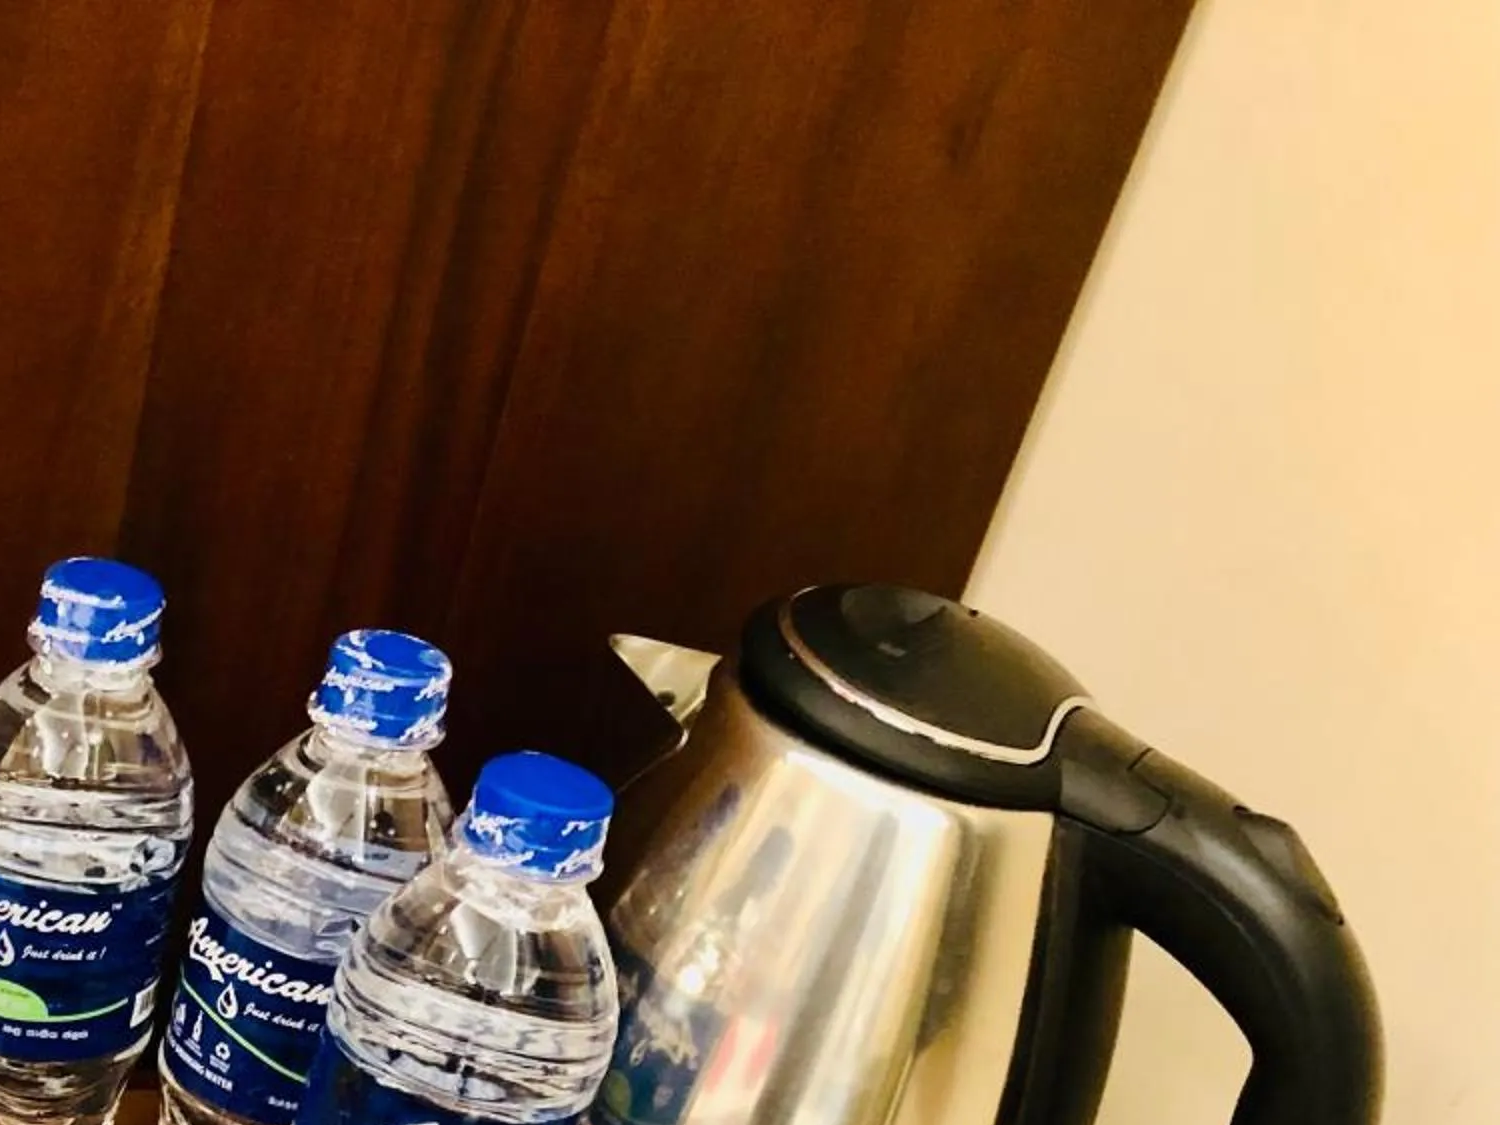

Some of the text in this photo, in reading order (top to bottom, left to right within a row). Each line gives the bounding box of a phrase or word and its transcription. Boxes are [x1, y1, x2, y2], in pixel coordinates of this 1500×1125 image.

[21, 944, 49, 960] Just
[52, 949, 83, 961] drink
[188, 917, 334, 1004] American
